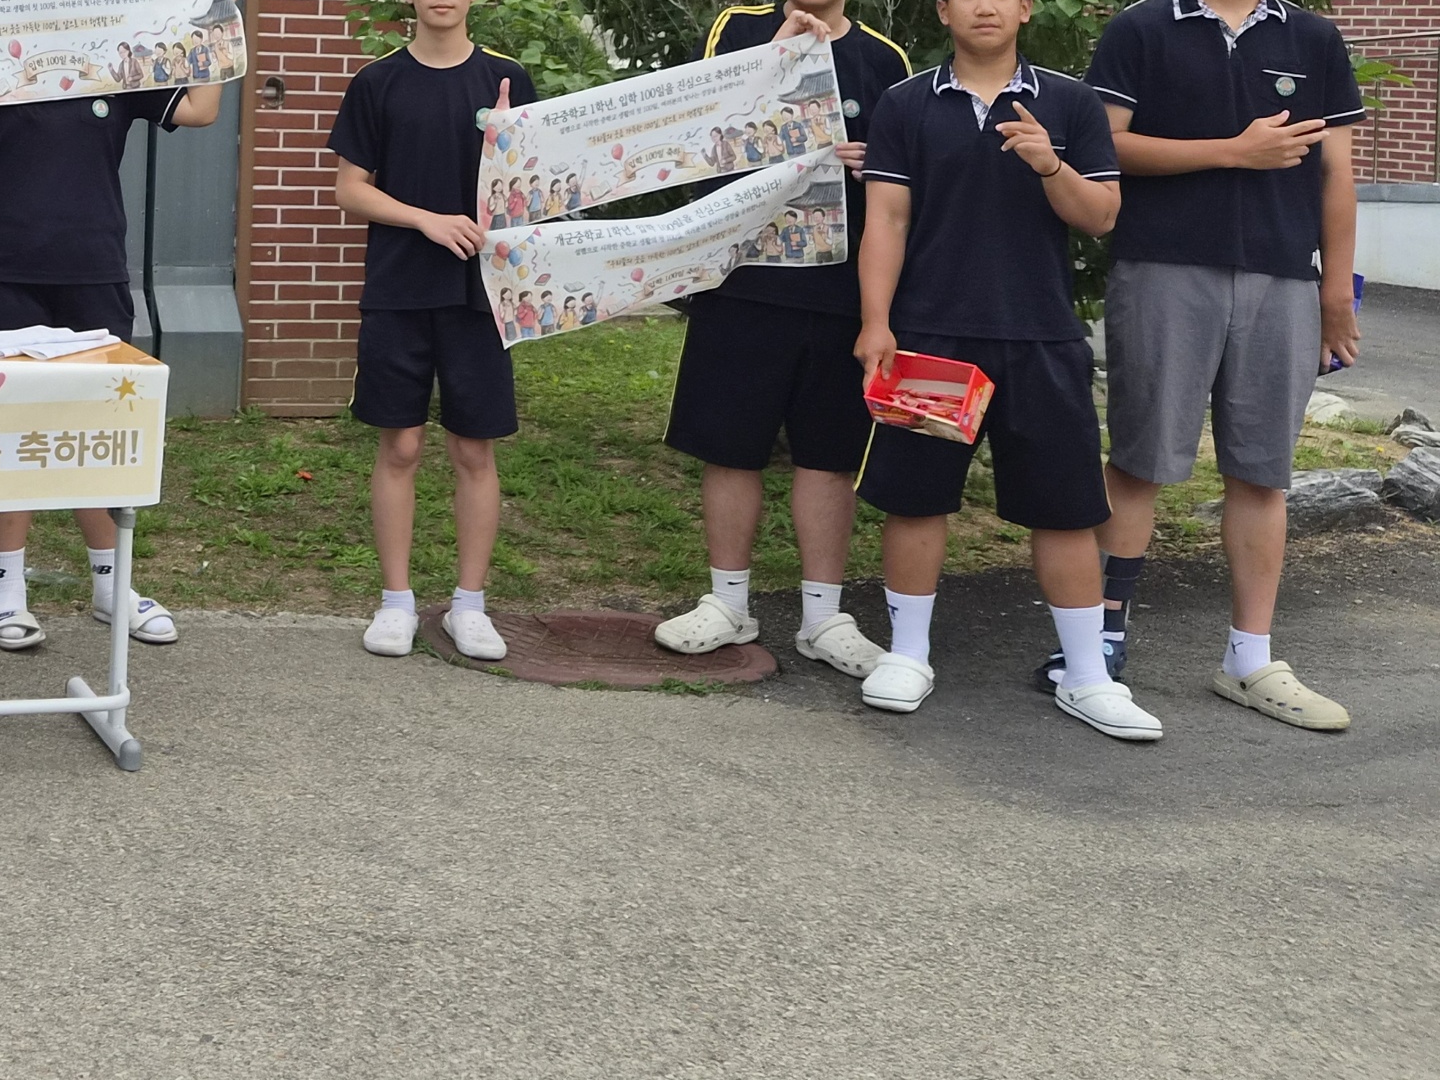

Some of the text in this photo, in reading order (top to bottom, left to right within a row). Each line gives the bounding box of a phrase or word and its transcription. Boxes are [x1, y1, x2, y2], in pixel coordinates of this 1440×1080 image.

[28, 55, 85, 70] 입학 100일 축하
[540, 105, 588, 126] 개군중학교
[618, 91, 637, 107] 입학
[640, 82, 673, 101] 100일을
[676, 72, 712, 91] 진심으로
[714, 59, 762, 80] 축하합니다!
[16, 430, 139, 468] 축하해!
